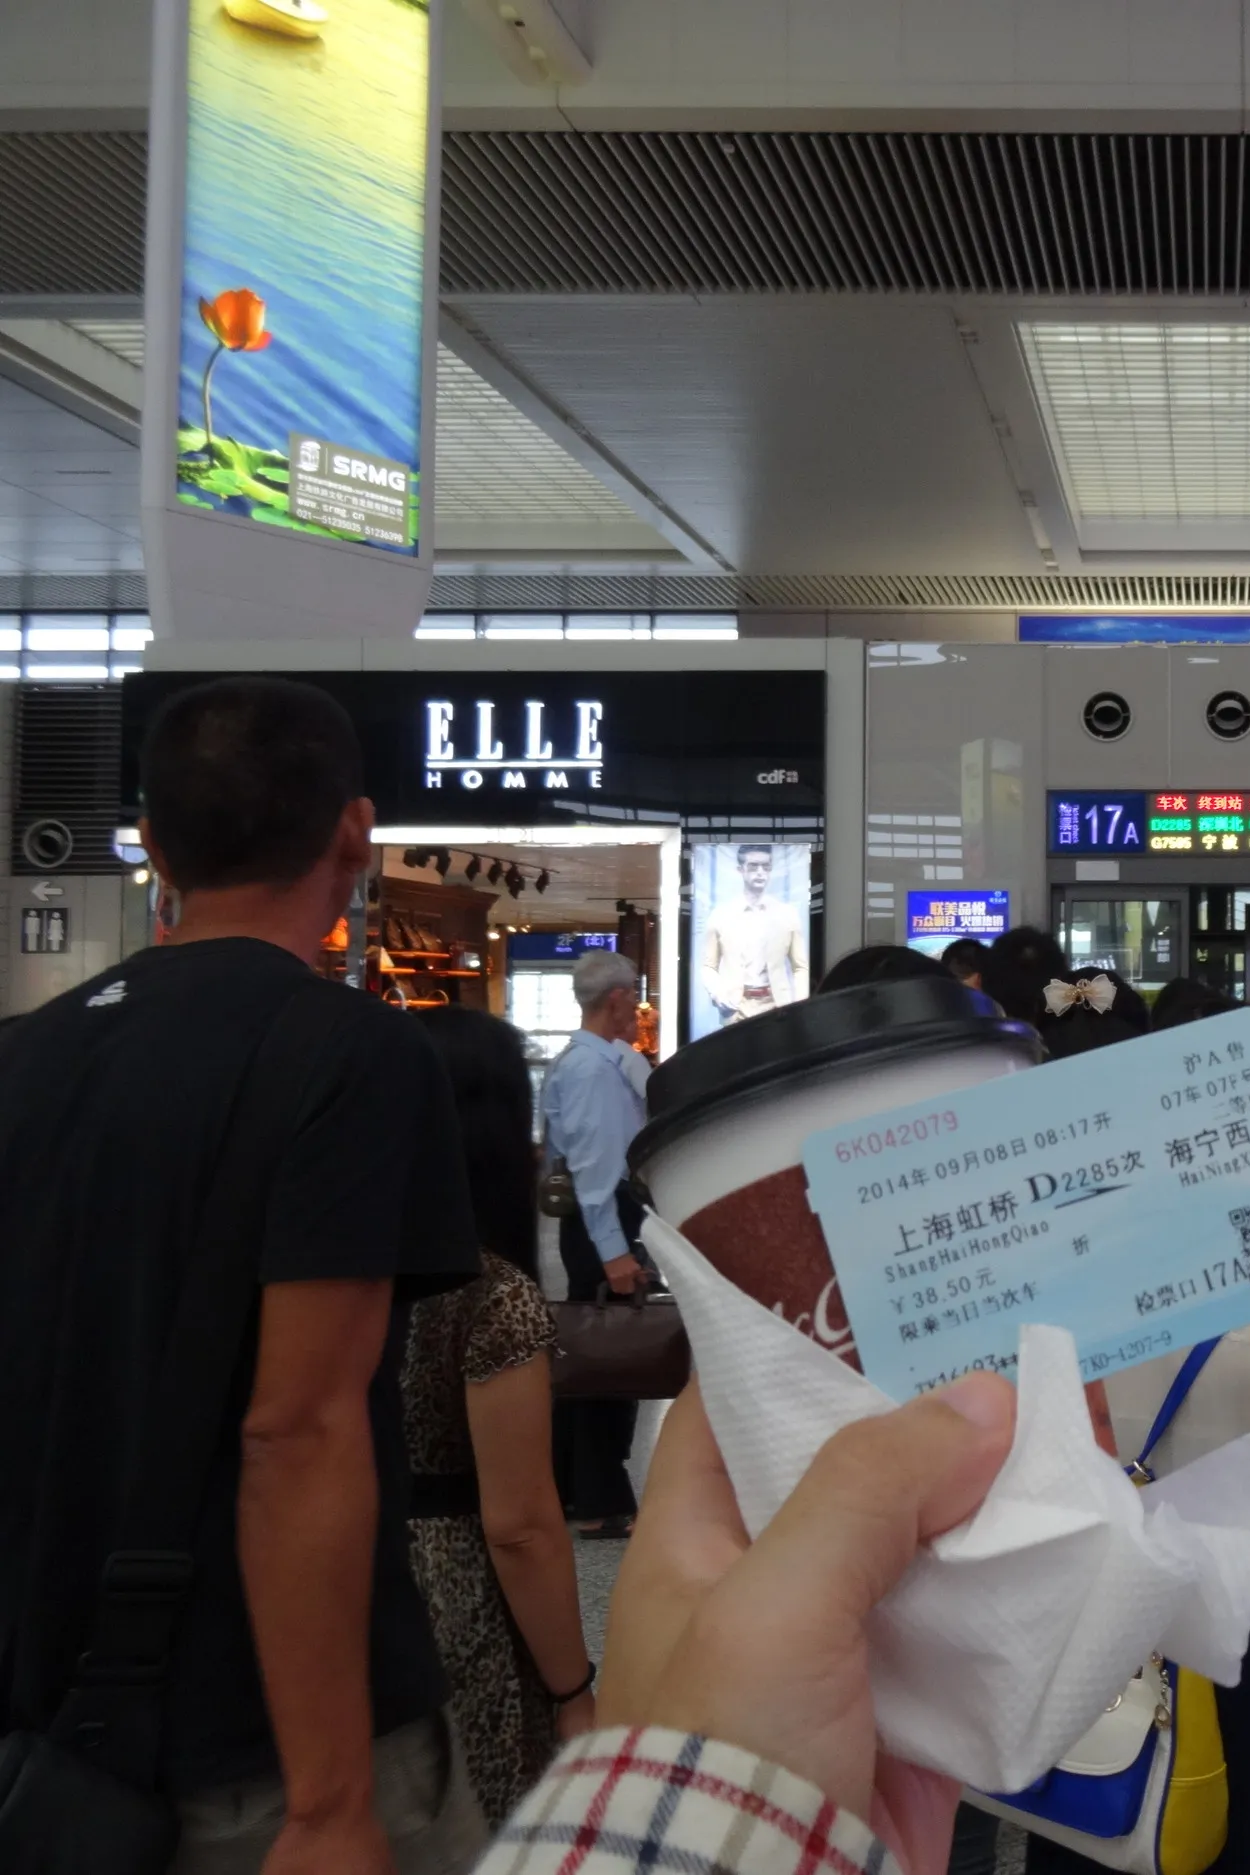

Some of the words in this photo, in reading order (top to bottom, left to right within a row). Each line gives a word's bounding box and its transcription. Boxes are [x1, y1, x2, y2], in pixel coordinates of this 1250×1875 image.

[333, 455, 406, 492] SRMG
[427, 702, 603, 760] ELLE
[427, 770, 603, 789] HOMME
[1157, 796, 1188, 810] 车次
[1198, 796, 1243, 810] 终到站
[1085, 804, 1140, 845] 17A
[835, 1110, 959, 1164] 6K042079
[894, 1190, 1019, 1257] 上海虹桥
